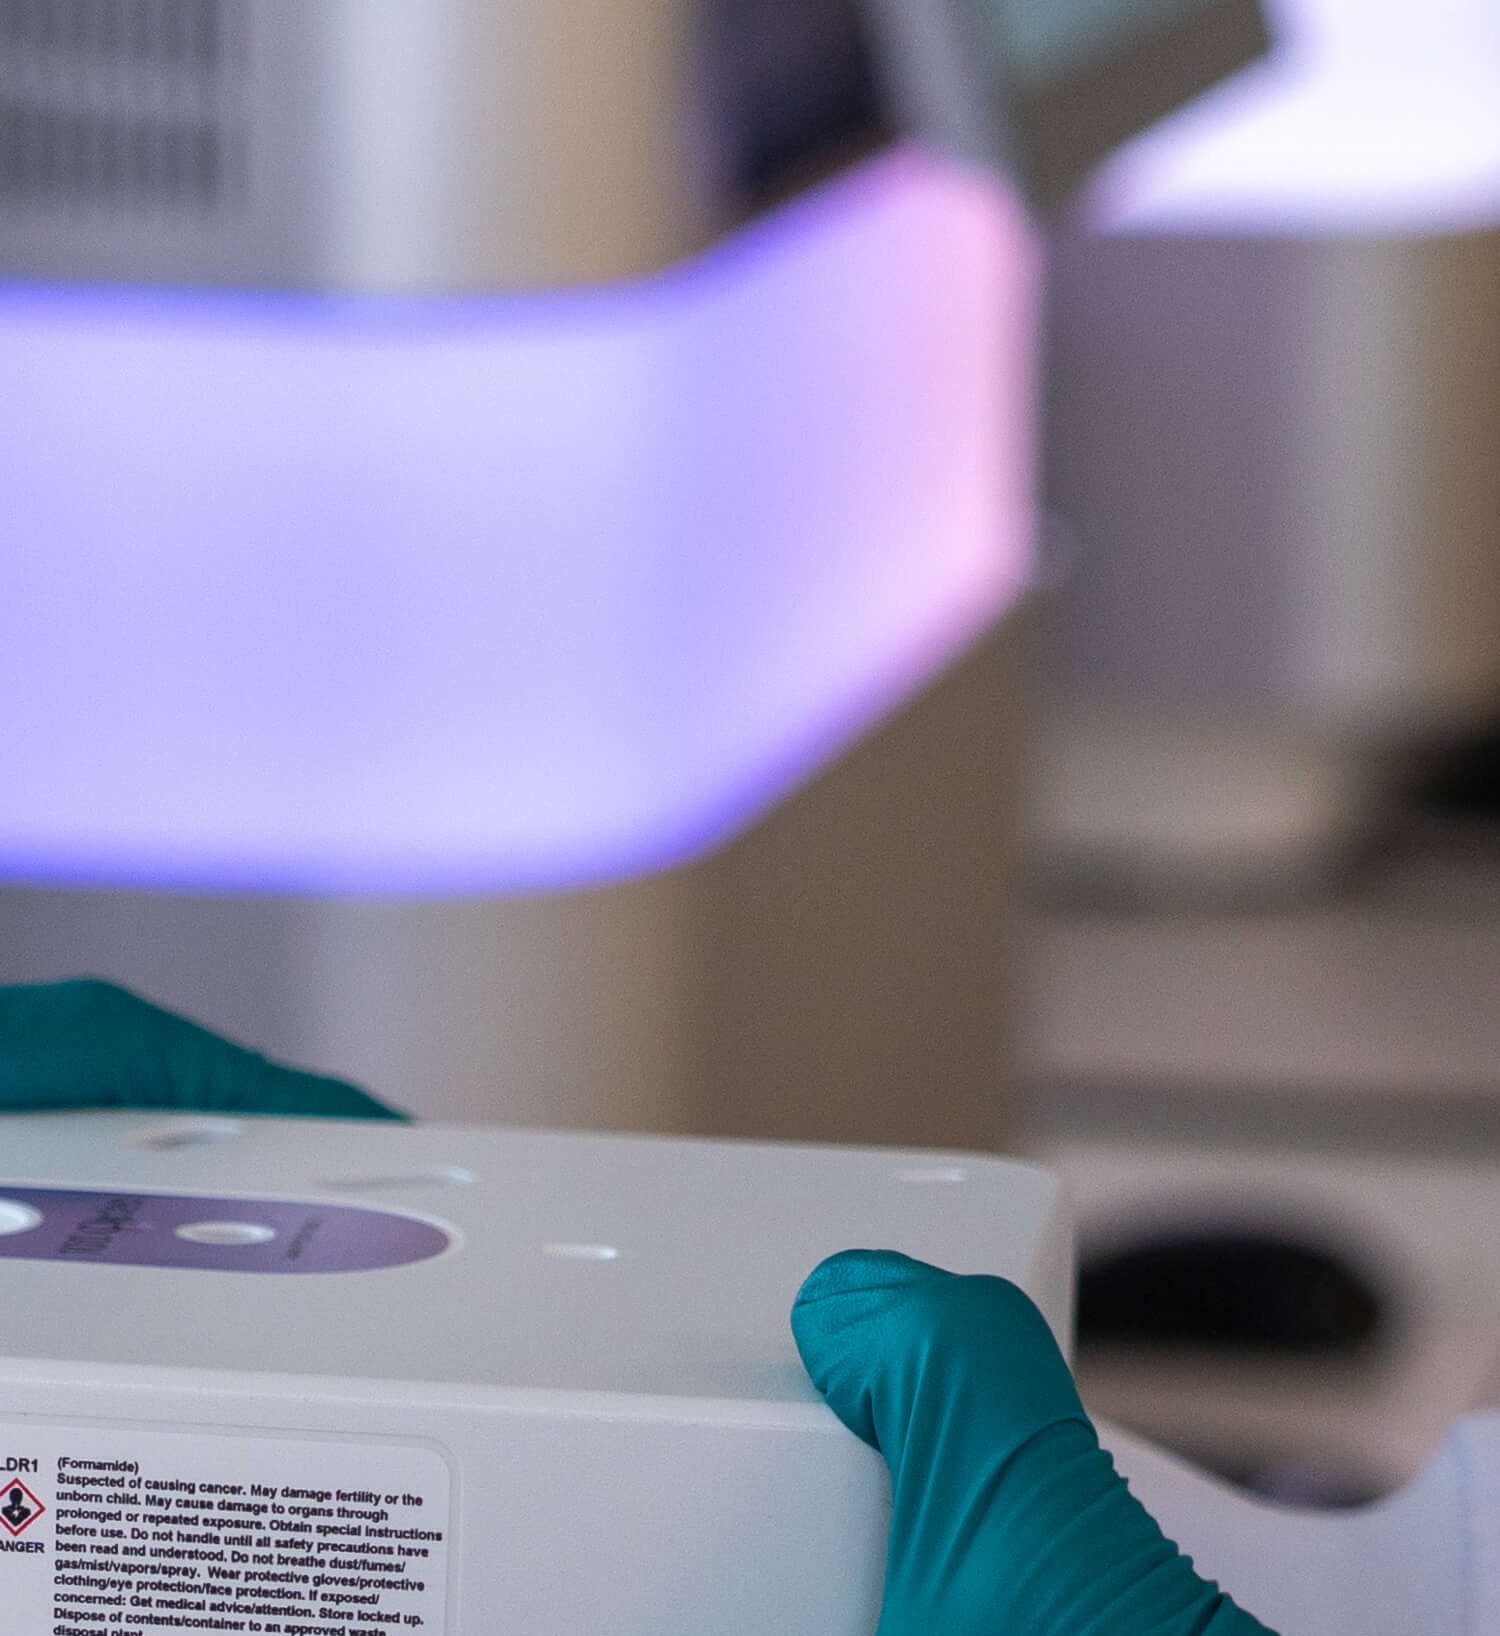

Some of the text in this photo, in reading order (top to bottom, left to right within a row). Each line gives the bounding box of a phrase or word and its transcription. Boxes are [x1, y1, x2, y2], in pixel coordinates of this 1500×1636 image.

[56, 1456, 139, 1474] (Formamide)
[55, 1489, 389, 1522] unborn child. May cause damage to organs through
[56, 1471, 423, 1507] Suspected of causing cancer. May damage fertility or the
[55, 1507, 443, 1541] prolonged or repeated exposure. Obtain special instructions
[55, 1522, 429, 1558] before use. Do not handle until all safety precautions have
[54, 1539, 406, 1573] been read and understood. Do not breathe dust/fumes/
[53, 1573, 380, 1606] clothing/eye protection/face protection. If exposed/
[54, 1557, 425, 1592] gas/mist/vapors/spray. Wear protective gloves/protective
[53, 1592, 424, 1625] concerned: Get medical advice/attention. Store locked up.
[53, 1606, 106, 1622] Dispose
[108, 1610, 123, 1623] of
[124, 1612, 246, 1631] contents/container
[248, 1619, 262, 1632] to
[263, 1622, 281, 1633] an
[283, 1623, 346, 1636] approved
